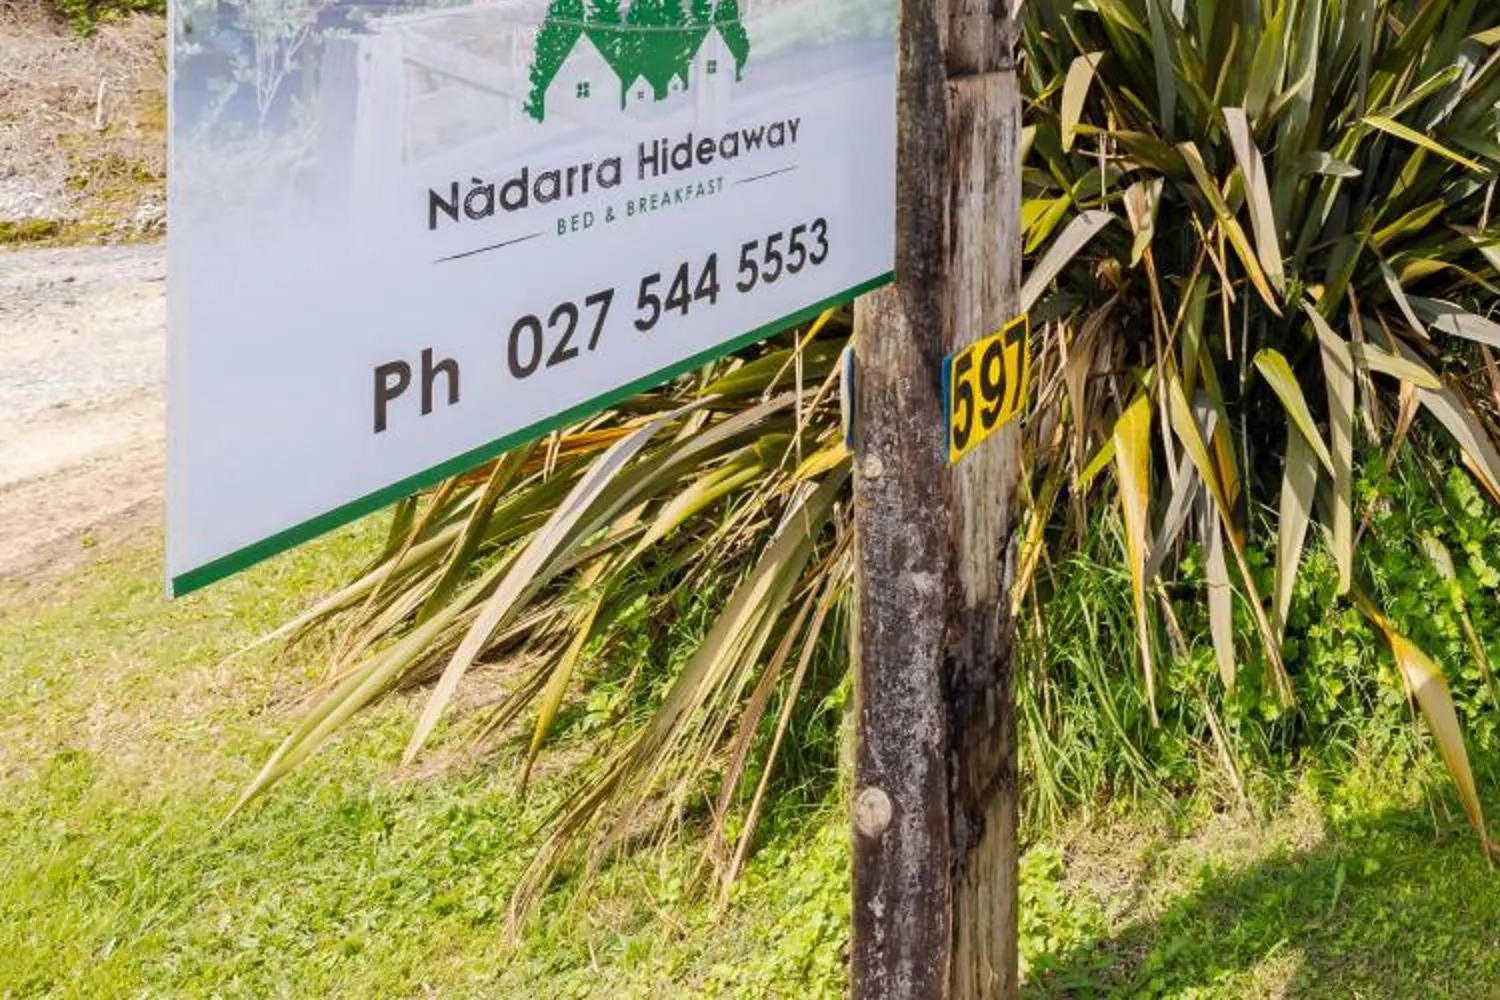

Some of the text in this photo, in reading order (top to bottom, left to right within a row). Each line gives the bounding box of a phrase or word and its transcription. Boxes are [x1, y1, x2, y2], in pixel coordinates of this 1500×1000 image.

[428, 117, 801, 231] Nàdarra Hideaway
[556, 177, 725, 236] BED & BREAKFAST
[374, 217, 830, 434] Ph 027 544 5553
[953, 319, 1026, 451] 597
